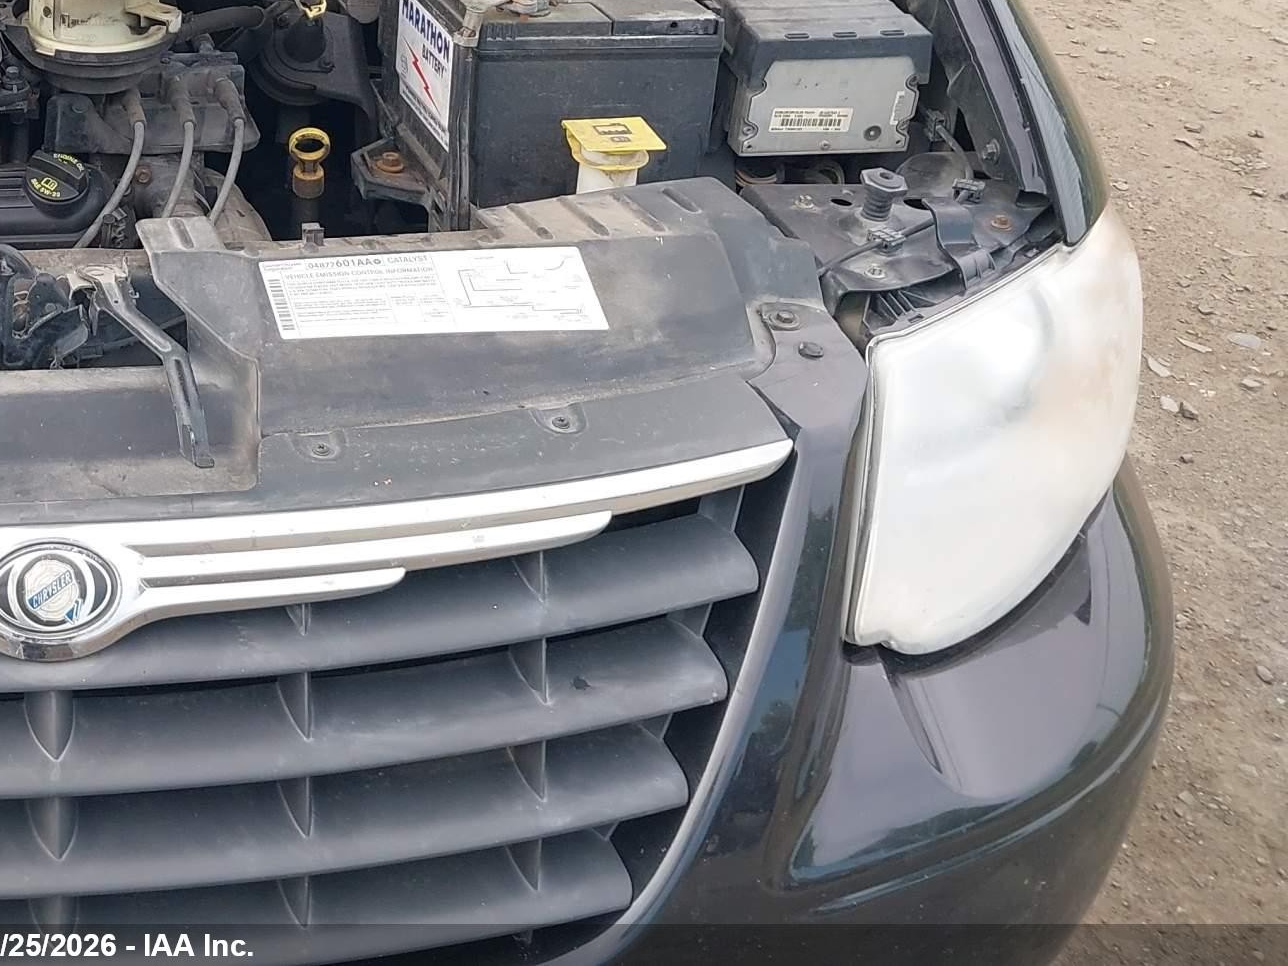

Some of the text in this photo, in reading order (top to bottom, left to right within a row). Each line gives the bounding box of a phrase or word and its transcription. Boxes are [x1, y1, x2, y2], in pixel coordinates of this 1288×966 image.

[421, 44, 445, 79] BATTERY
[53, 153, 78, 165] ENGINE
[387, 255, 428, 265] CATALYST
[285, 266, 434, 280] VEHICLE EMISSION CONTROL INFORMATION
[31, 570, 73, 607] CHRYSLER
